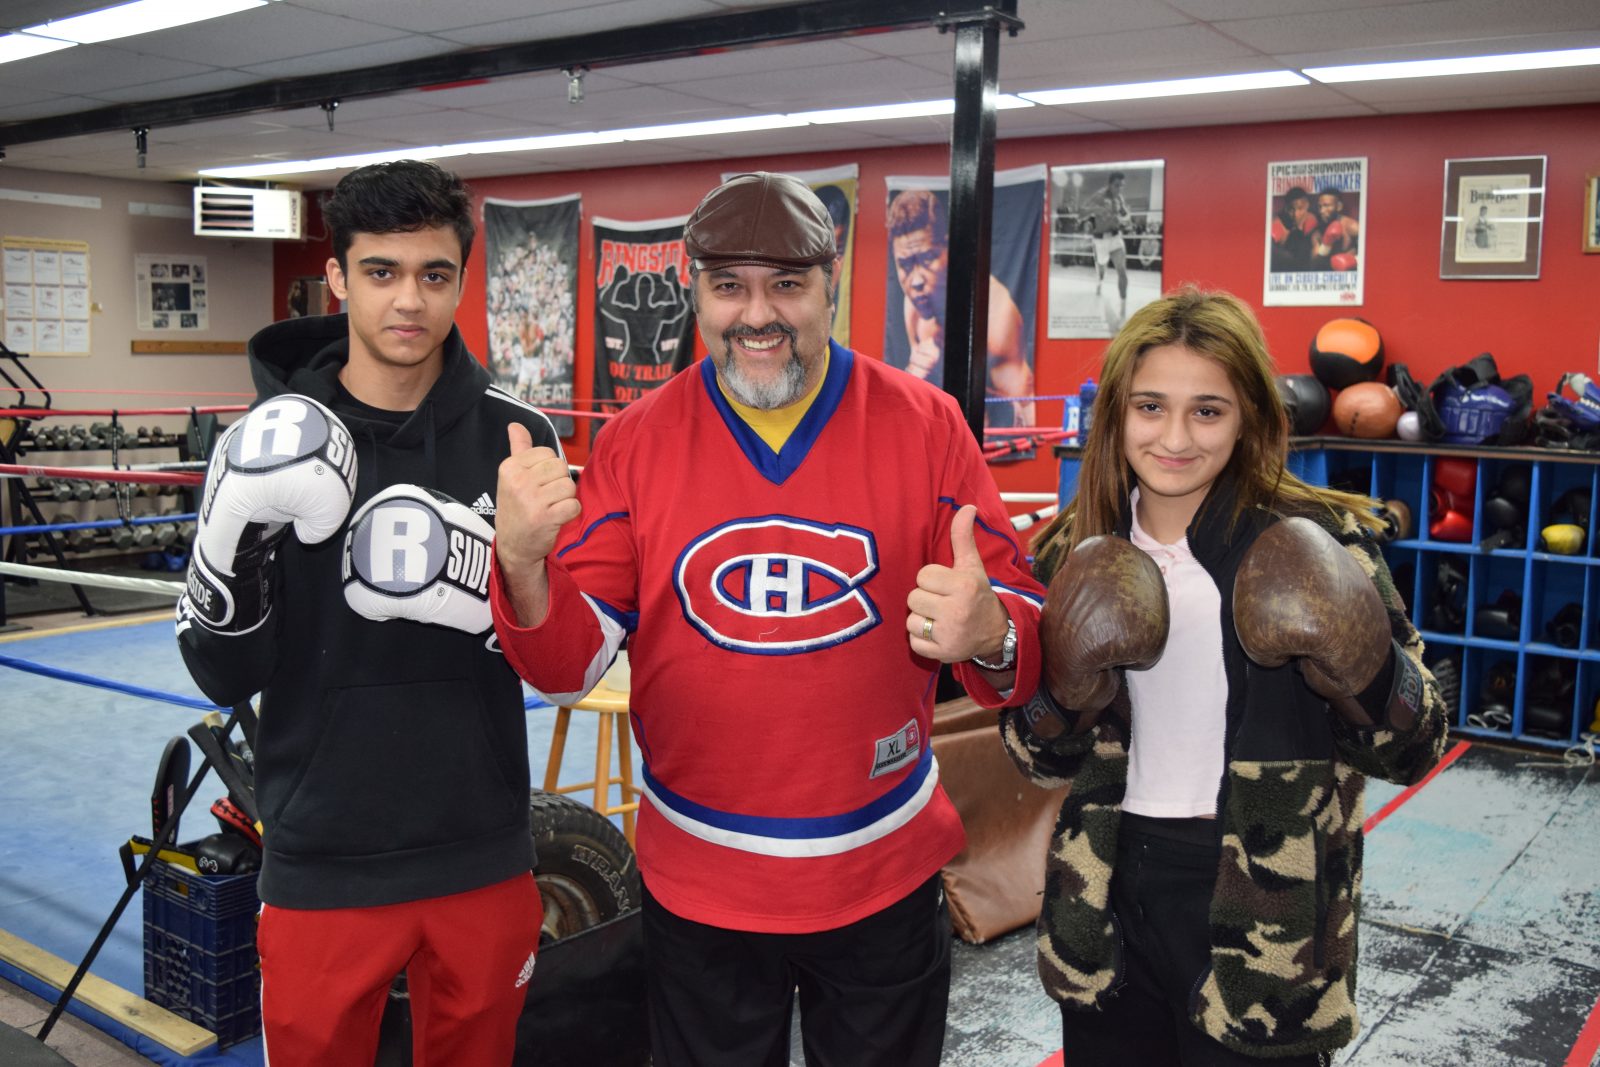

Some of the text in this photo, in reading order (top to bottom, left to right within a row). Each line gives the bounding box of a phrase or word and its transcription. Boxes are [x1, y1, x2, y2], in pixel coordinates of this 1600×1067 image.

[1272, 164, 1290, 176] EPIC
[1307, 161, 1361, 174] SHOWDOWN
[240, 400, 308, 465] R
[370, 506, 431, 584] R
[887, 739, 901, 758] XL
